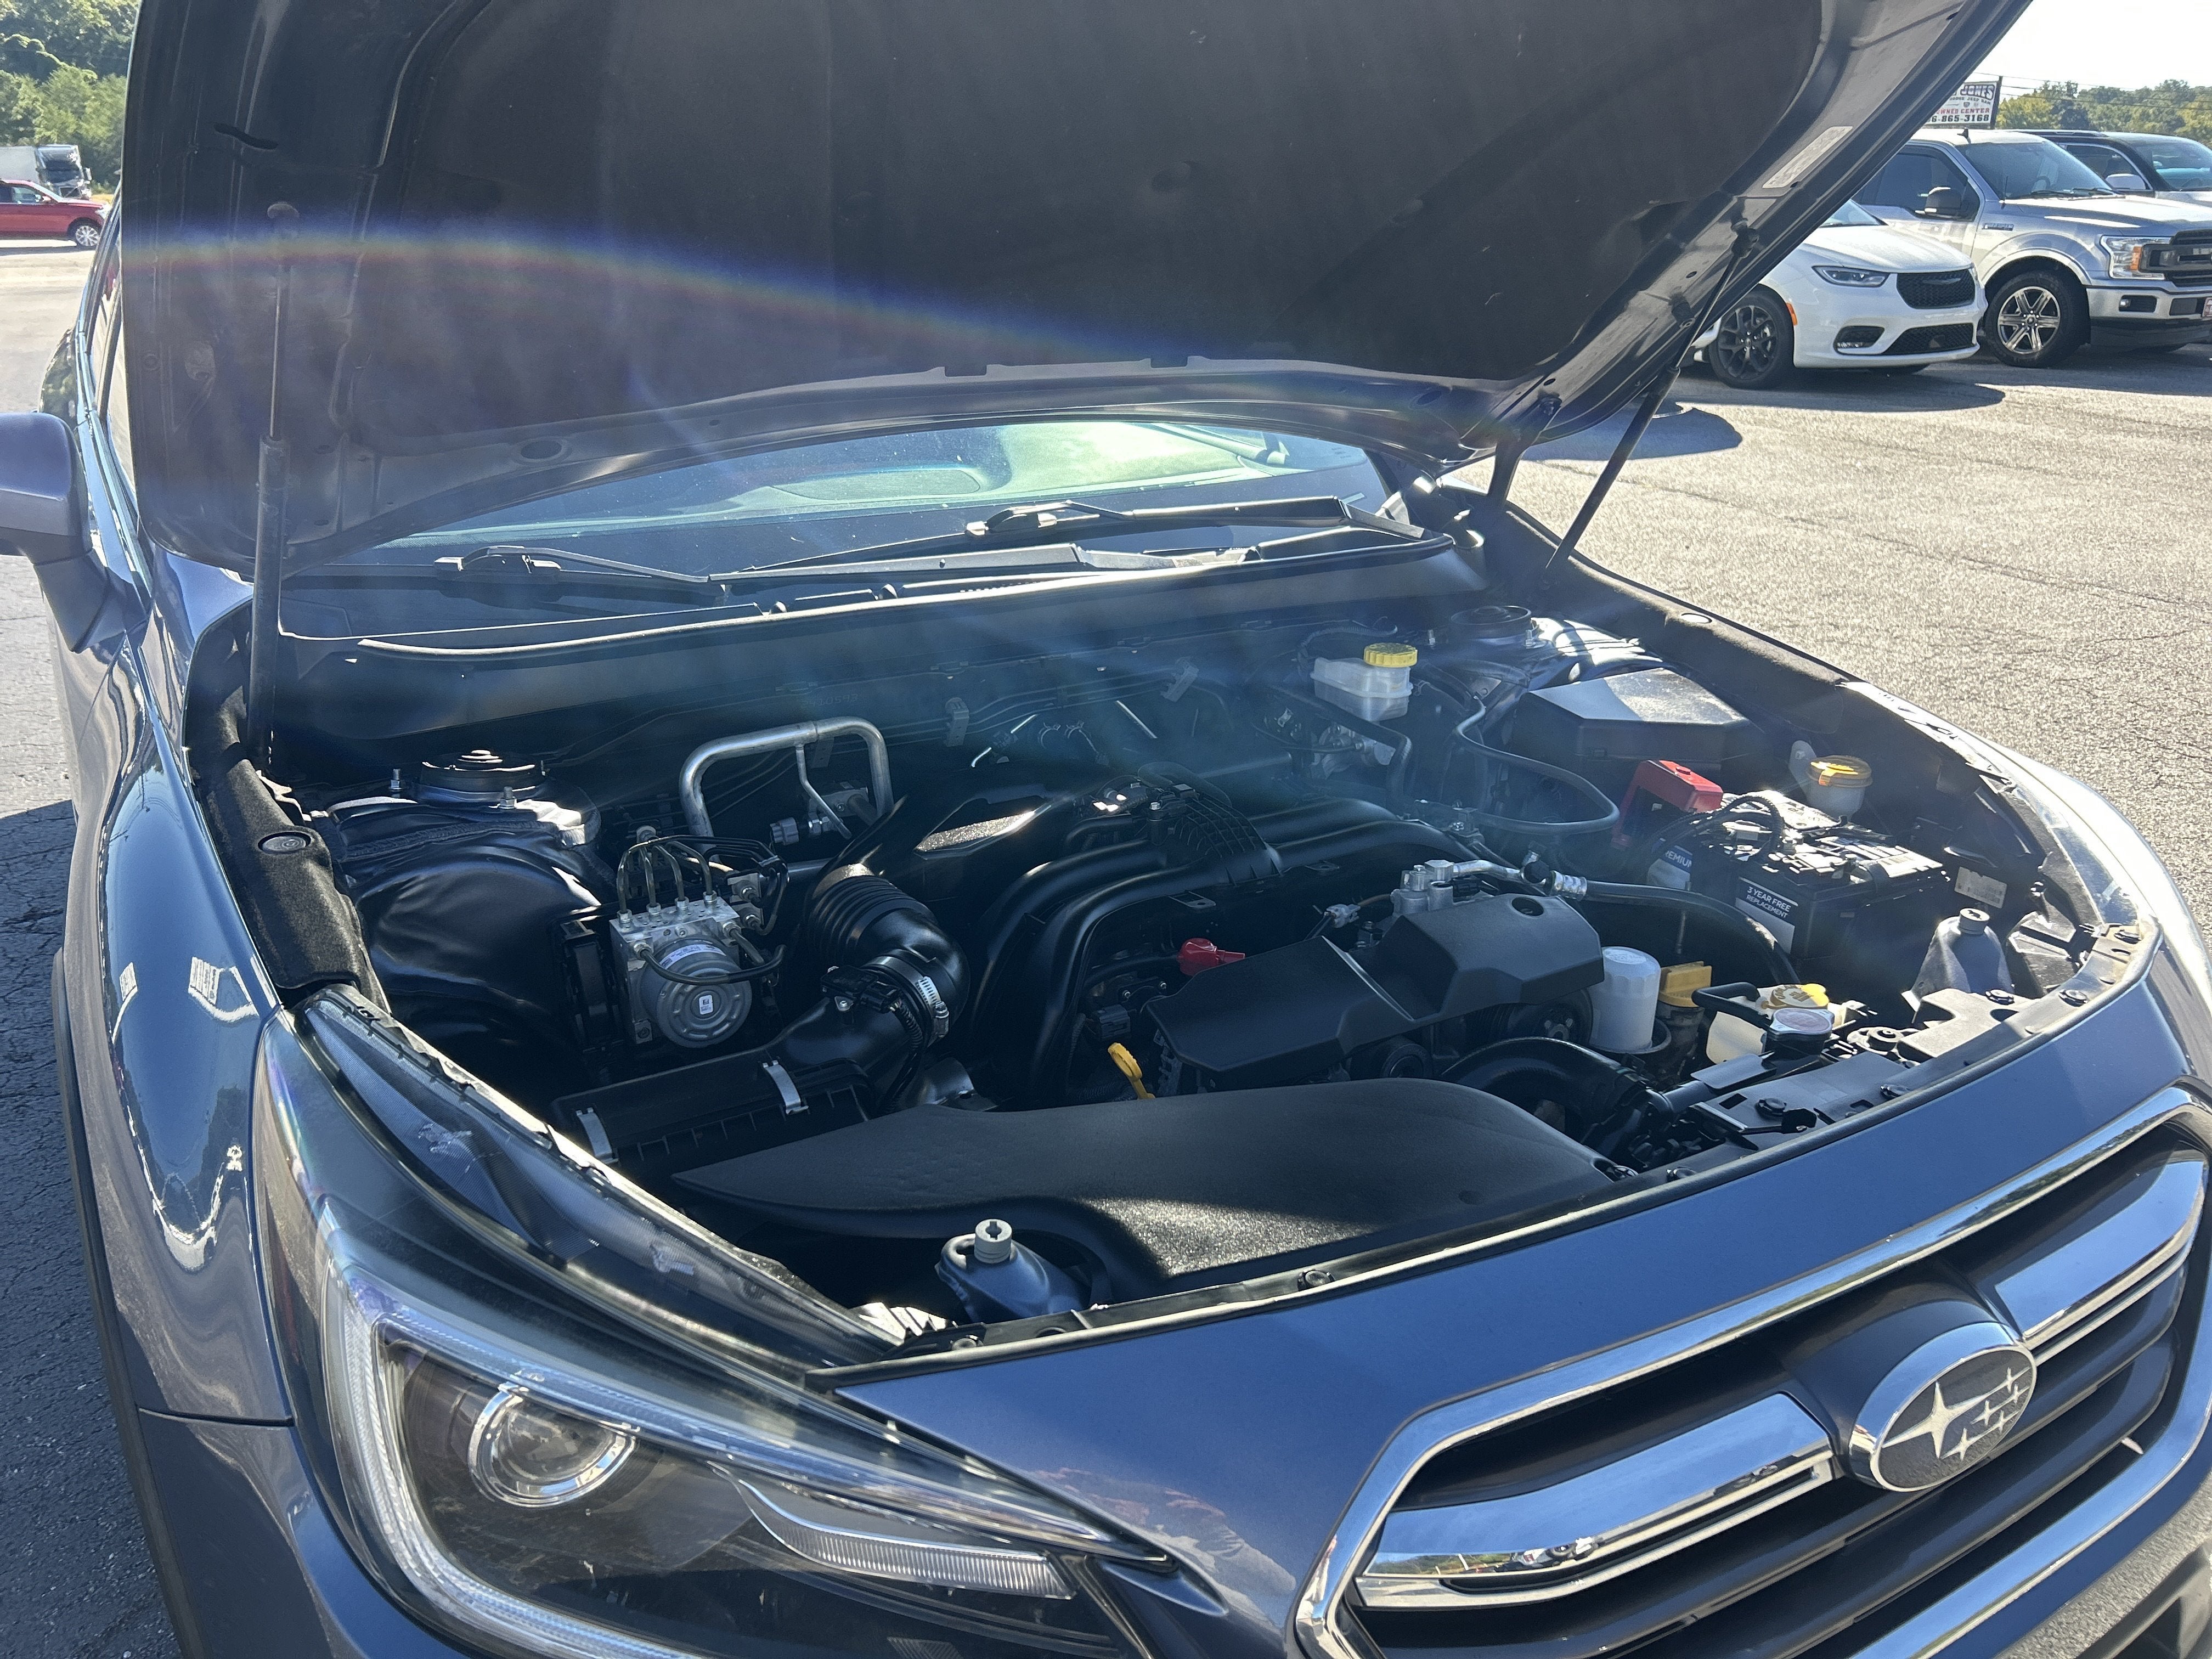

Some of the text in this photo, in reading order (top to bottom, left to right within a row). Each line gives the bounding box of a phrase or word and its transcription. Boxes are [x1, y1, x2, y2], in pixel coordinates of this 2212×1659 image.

[1960, 84, 1995, 100] JONES
[1746, 894, 1788, 918] REPLACEMENT
[1754, 889, 1772, 902] YEAR
[1772, 899, 1791, 912] FREE
